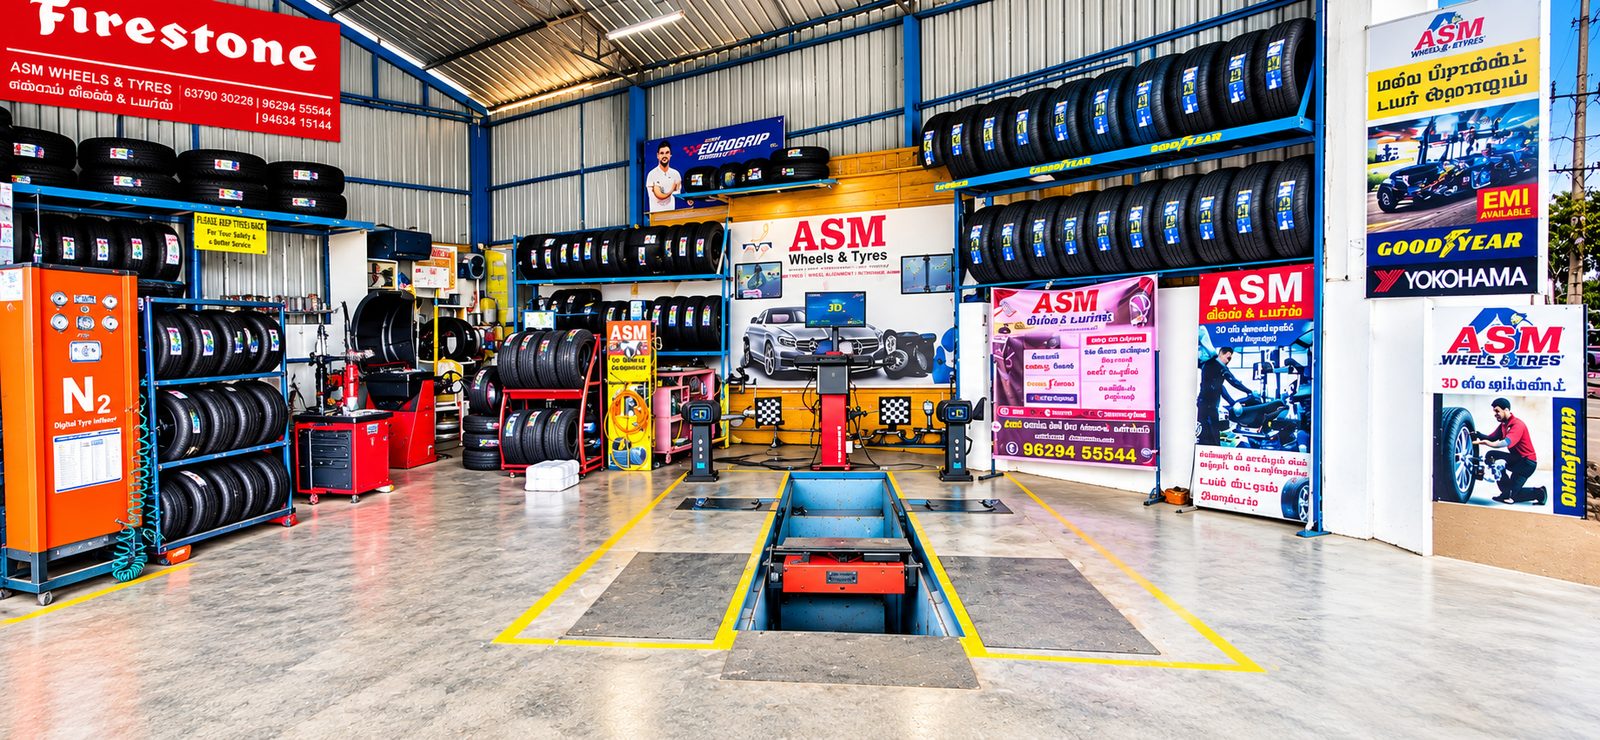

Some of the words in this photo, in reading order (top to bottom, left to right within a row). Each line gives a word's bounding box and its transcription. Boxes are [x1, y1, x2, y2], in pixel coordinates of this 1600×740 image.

[30, 0, 317, 71] Firestone
[1413, 17, 1485, 50] ASM
[10, 61, 43, 76] ASM
[48, 66, 109, 85] WHEELS
[114, 76, 123, 88] &
[128, 78, 172, 95] TYRES
[116, 93, 126, 105] &
[184, 87, 217, 101] 63790
[220, 92, 253, 106] 30228
[262, 98, 296, 112] 96294
[299, 103, 331, 117] 55544
[262, 113, 296, 126] 94634
[300, 118, 331, 131] 15144
[697, 132, 770, 155] EUROGRIP
[1483, 188, 1529, 209] EMI
[1480, 207, 1531, 219] AVAILABLE
[789, 214, 886, 252] ASM
[1377, 228, 1523, 258] GOODYEAR
[789, 252, 834, 265] Wheels
[838, 251, 848, 262] &
[851, 250, 888, 264] Tyres
[1209, 271, 1302, 306] ASM
[1405, 267, 1528, 289] YOKOHAMA
[1032, 289, 1099, 314] ASM
[1246, 307, 1255, 318] &
[610, 324, 647, 340] ASM
[1447, 326, 1563, 354] ASM
[1441, 377, 1458, 388] 3D
[78, 419, 92, 428] Tyre
[1023, 442, 1076, 459] 96294
[1081, 446, 1137, 463] 55544
